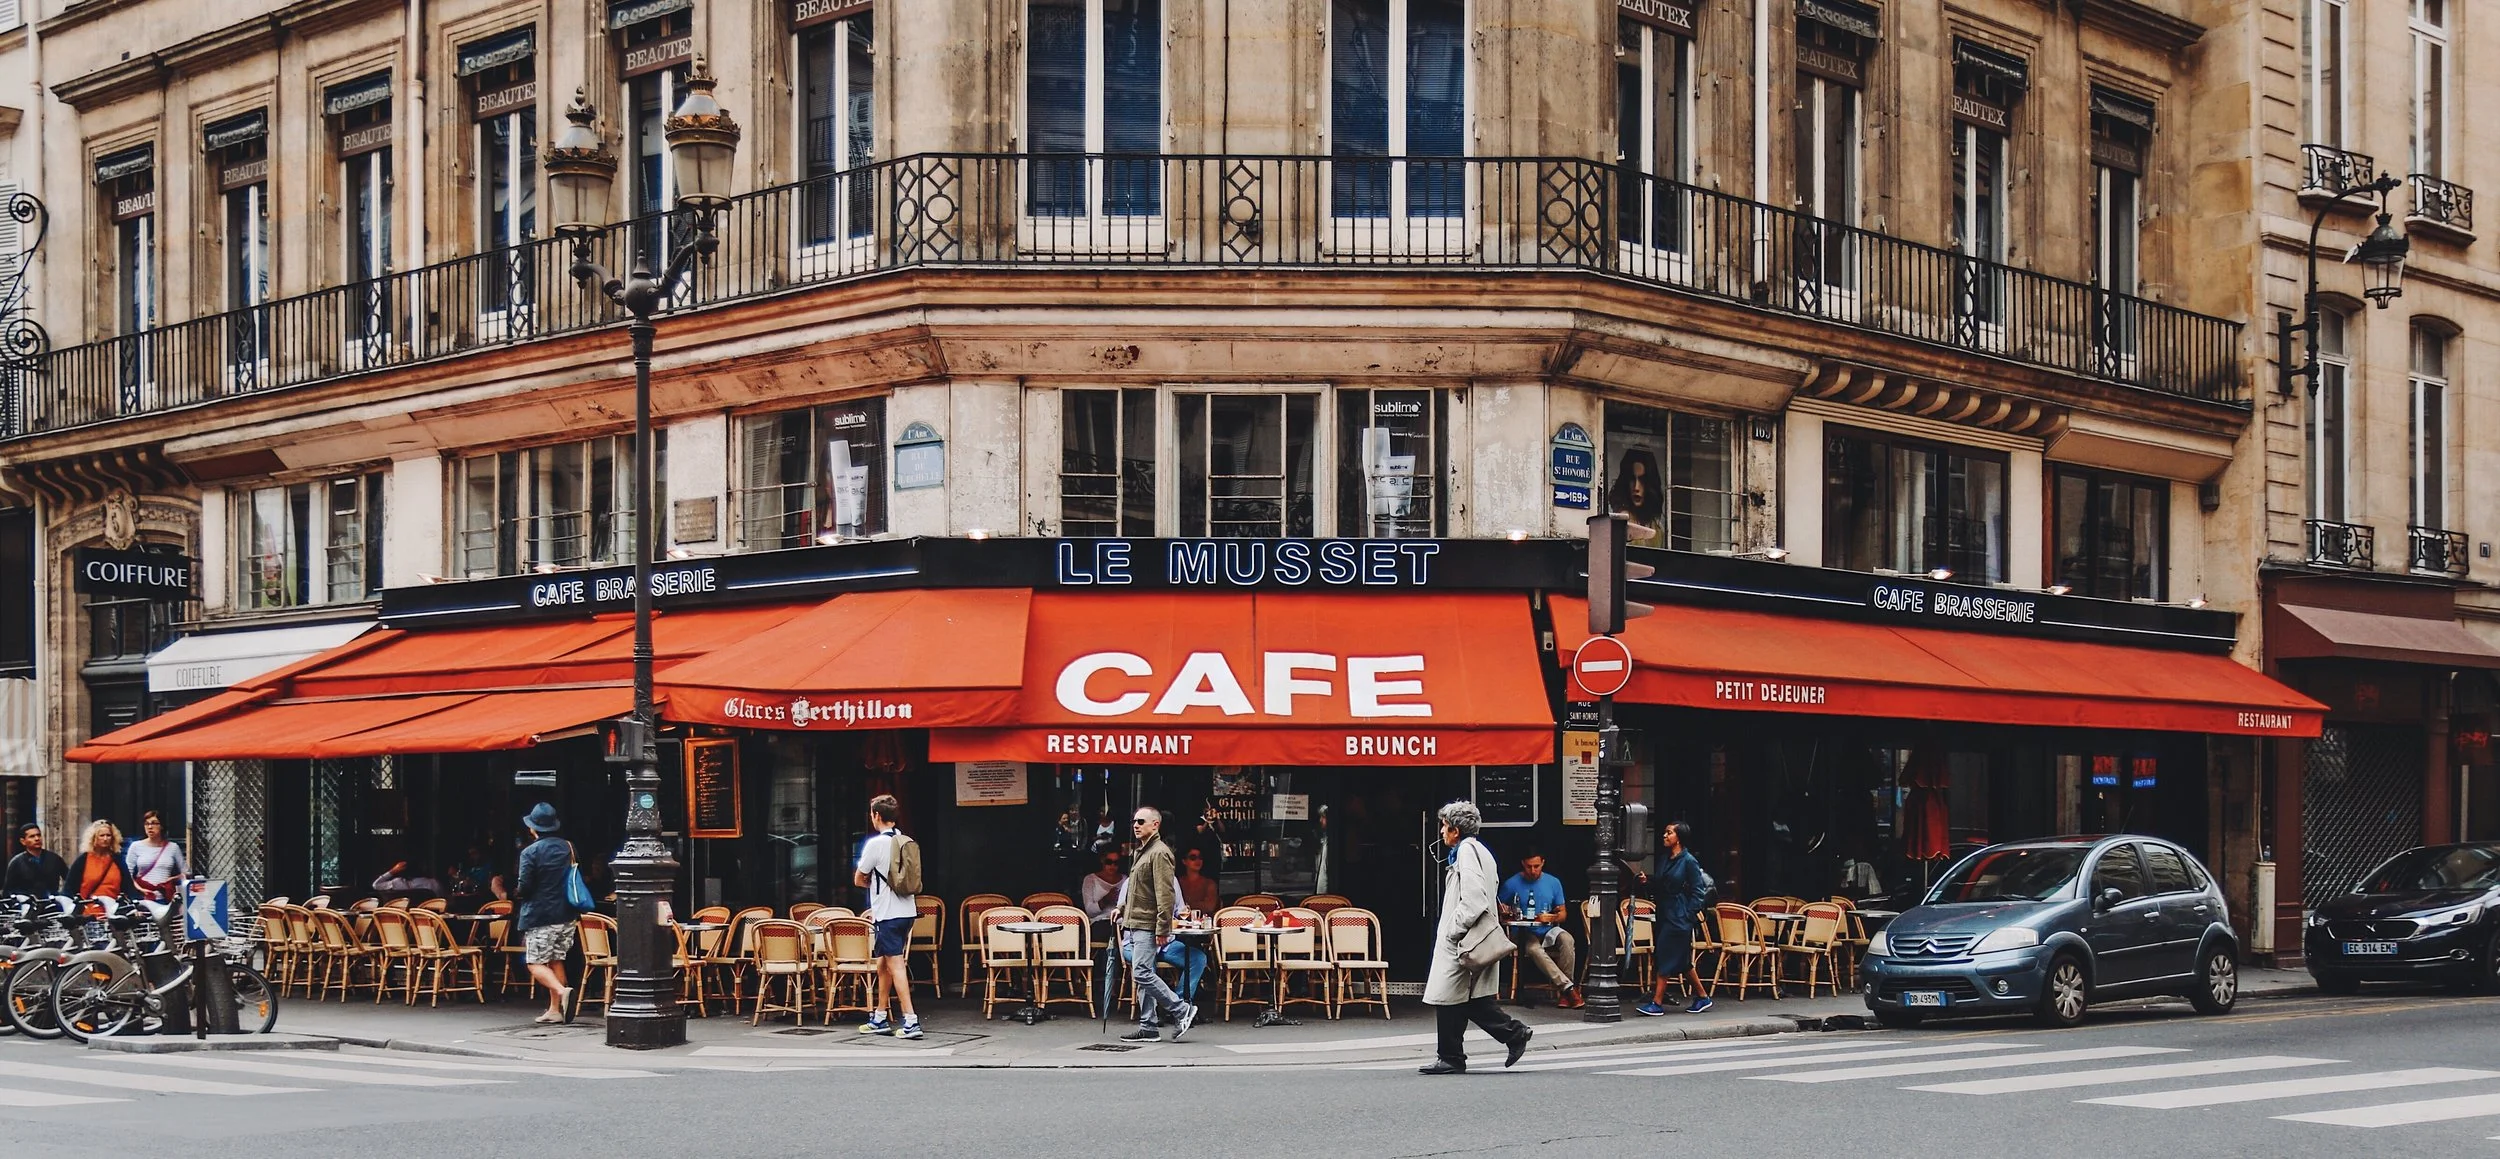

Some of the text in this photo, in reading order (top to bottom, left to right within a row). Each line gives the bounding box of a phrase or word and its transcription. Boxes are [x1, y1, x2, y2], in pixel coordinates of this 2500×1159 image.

[1617, 0, 1691, 29] EAUTEX
[1565, 454, 1580, 465] RUE
[1562, 466, 1590, 479] HONORÉ
[1569, 491, 1583, 503] 169
[86, 561, 188, 588] COIFFURE
[1059, 542, 1440, 585] LE MUSSET
[533, 568, 716, 607] CAFE BRASERIE
[1874, 585, 2035, 623] CAFE BRASSERIE
[176, 666, 222, 688] COIFFURE
[1055, 651, 1433, 717] CAFE
[1716, 681, 1825, 704] PETIT DEJEUNER
[724, 696, 913, 727] Glaces Berthillon
[2238, 713, 2292, 729] RESTAURANT
[1047, 734, 1437, 757] RESTAURANT BRUNCH
